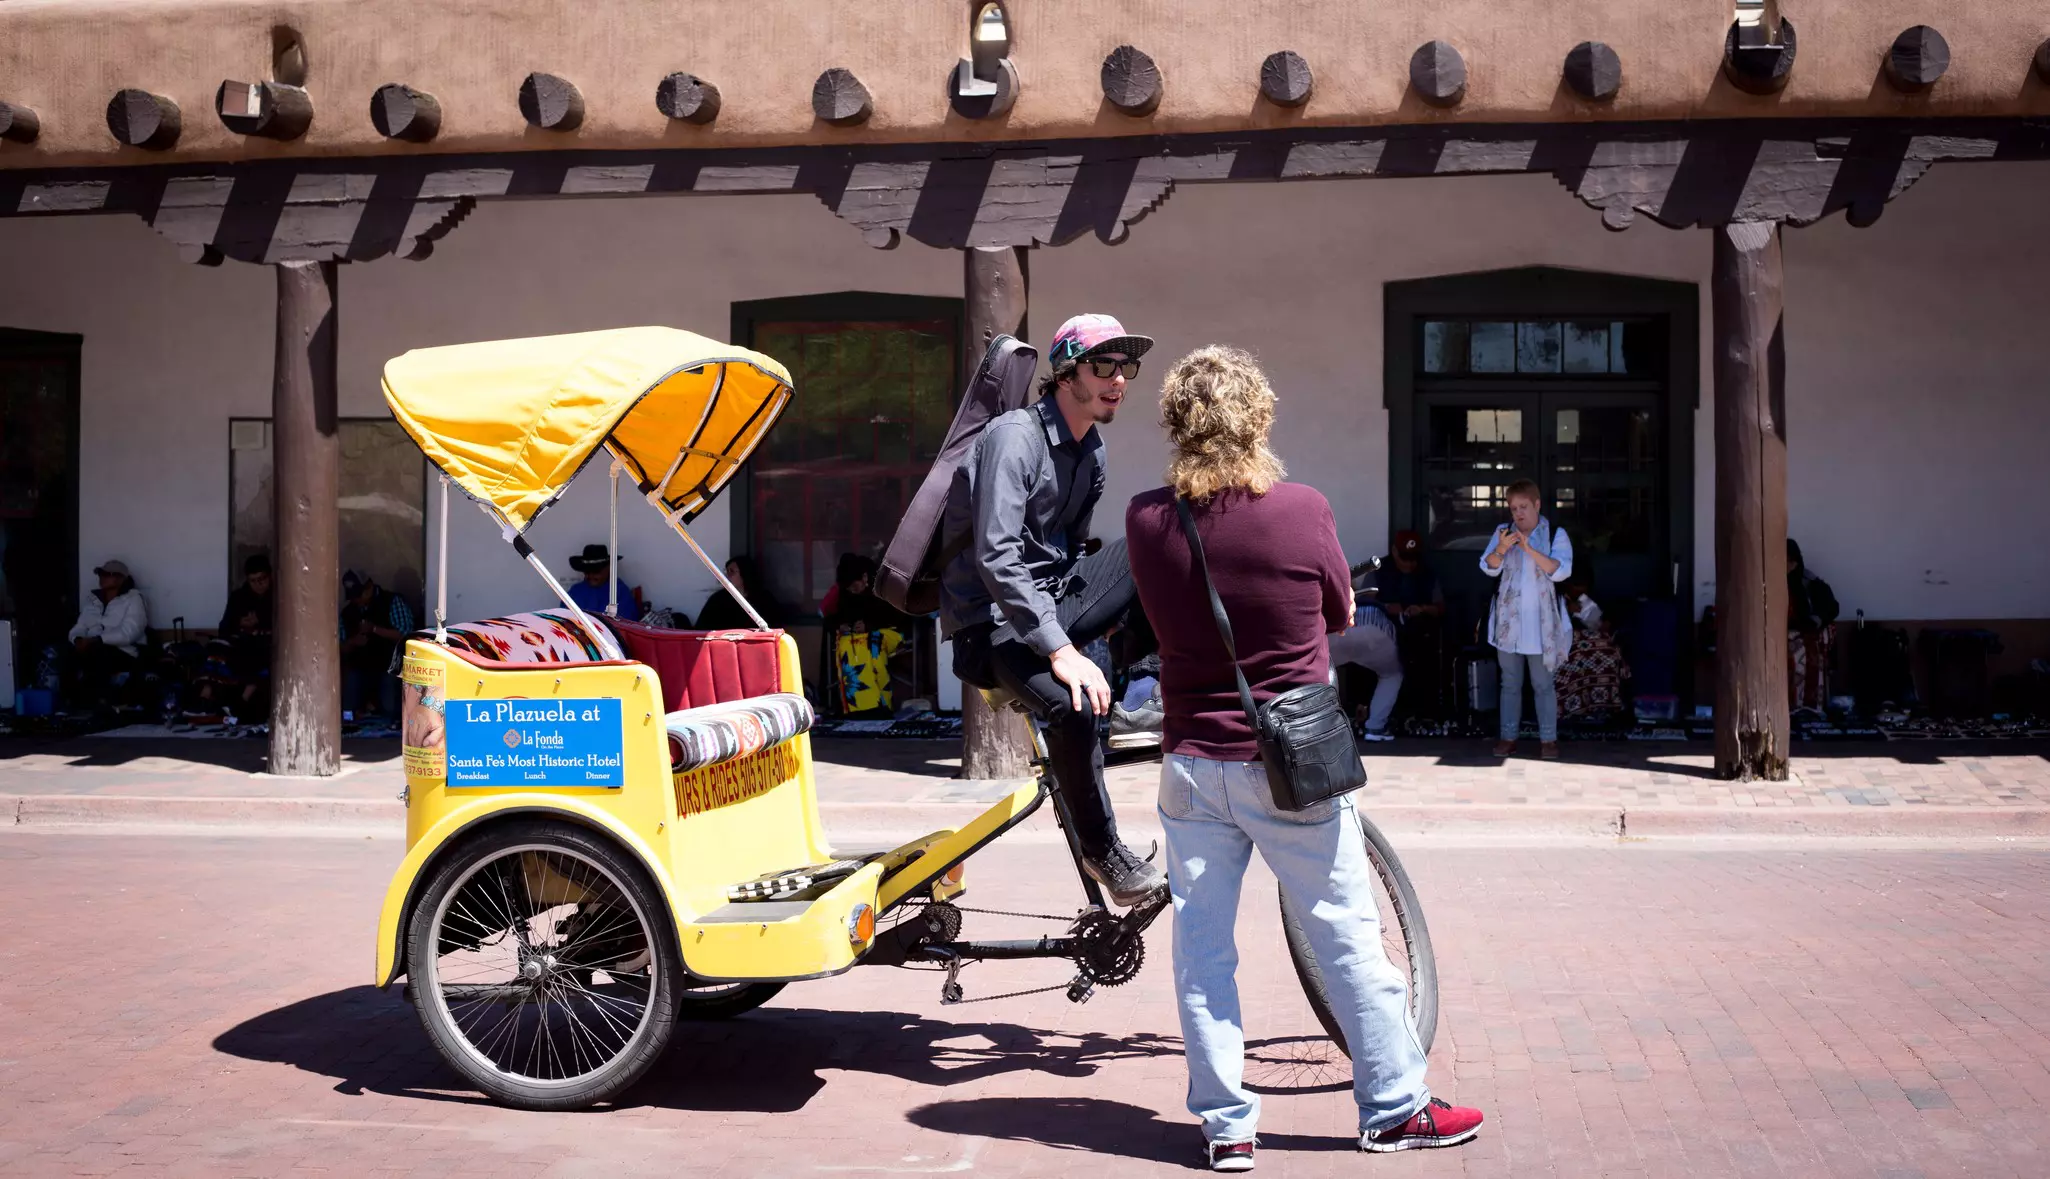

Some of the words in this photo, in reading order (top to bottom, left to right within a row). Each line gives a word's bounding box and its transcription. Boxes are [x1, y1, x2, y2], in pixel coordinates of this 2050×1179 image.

[465, 703, 492, 723] La
[495, 700, 577, 723] Plazuela
[581, 704, 601, 722] at
[522, 730, 533, 745] La
[535, 730, 564, 749] Fonda
[449, 754, 484, 768] Santa
[486, 754, 506, 768] Fe's
[507, 754, 536, 768] Most
[538, 754, 585, 768] Historic
[587, 752, 621, 767] Hotel
[456, 771, 490, 780] Breakfast
[524, 771, 547, 780] Lunch
[585, 771, 611, 780] Dinner
[701, 769, 712, 811] &
[709, 760, 739, 808] RIDES
[740, 754, 757, 797] 505
